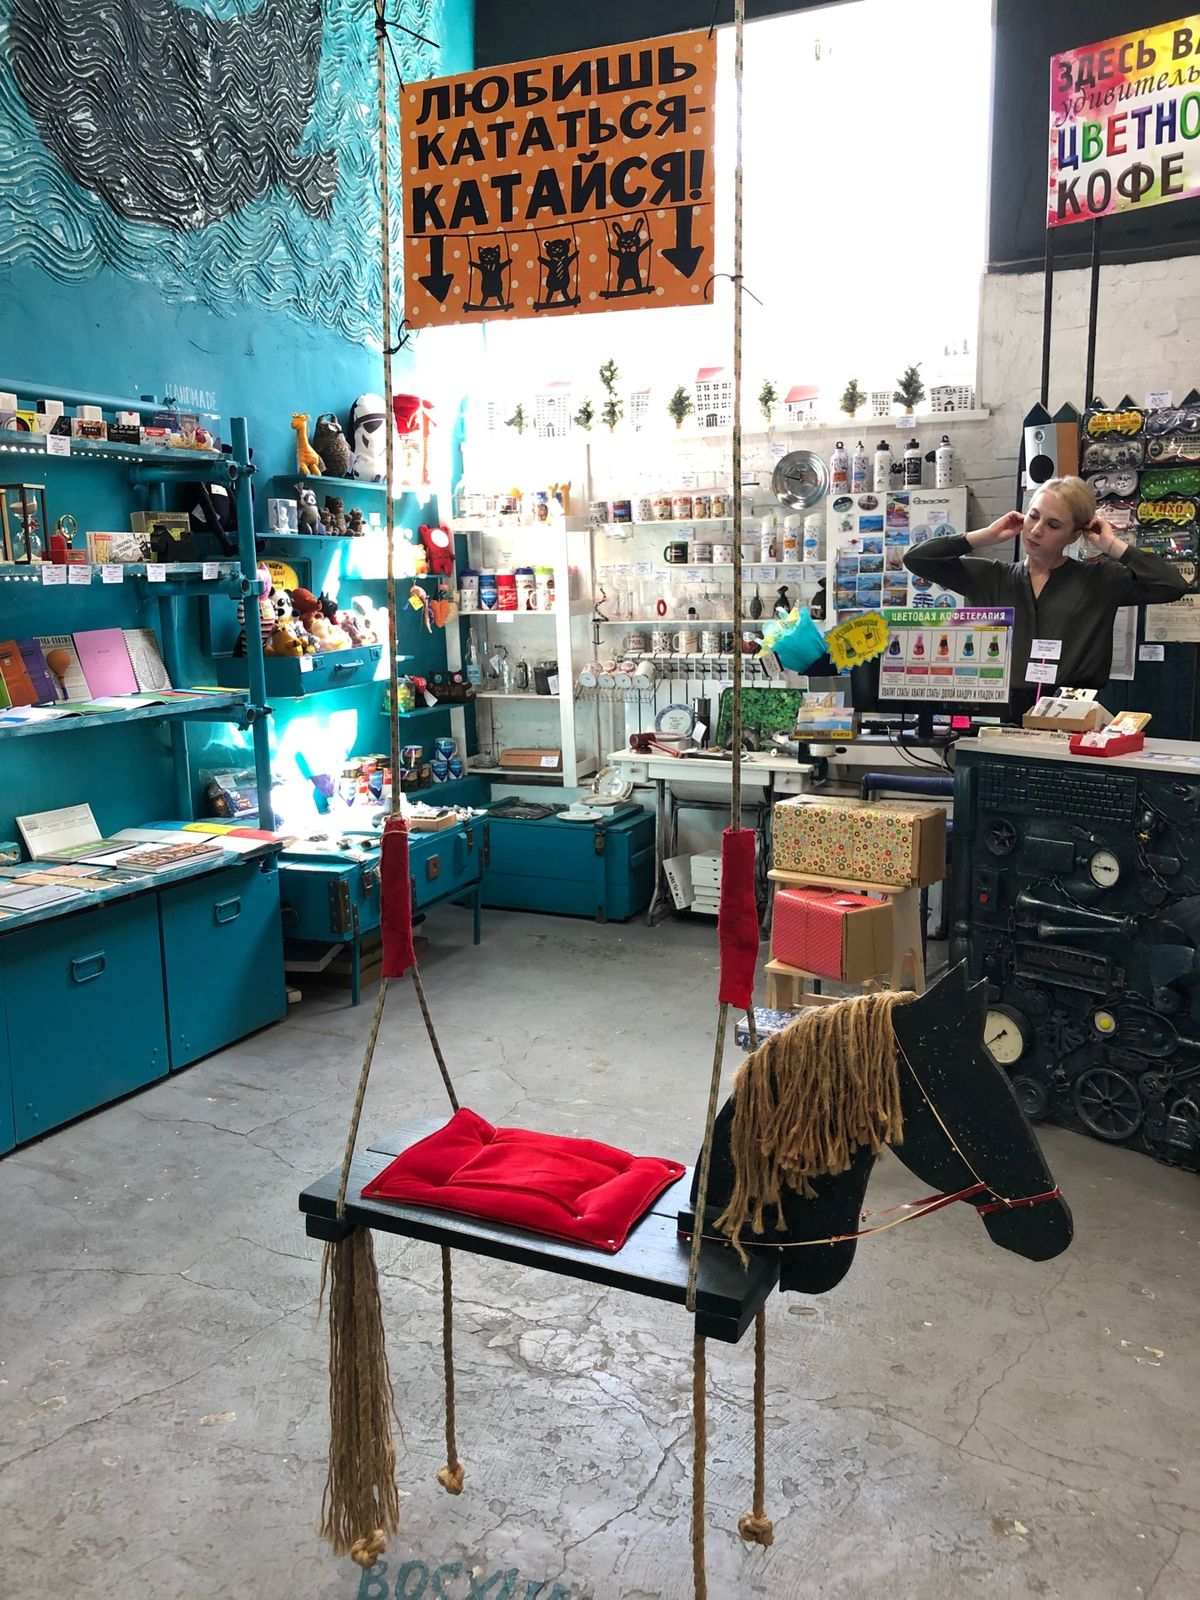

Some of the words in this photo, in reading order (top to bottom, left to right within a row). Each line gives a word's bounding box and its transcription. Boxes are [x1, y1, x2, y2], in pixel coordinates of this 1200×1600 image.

[416, 46, 698, 126] ЛЮБИШЬ
[1058, 39, 1156, 93] ЗДЕСЬ
[1172, 28, 1200, 61] В
[417, 95, 707, 171] КАТАТЬСЯ-
[1058, 91, 1200, 171] ЦВЕТНО
[411, 149, 706, 234] КАТАЙСЯ!
[1057, 151, 1185, 220] КОФЕ
[165, 383, 218, 411] HANDMADE
[1152, 504, 1183, 513] ТИХО
[891, 612, 936, 622] ЦВЕТОВАЯ
[940, 611, 1006, 621] КОФЕТЕРАПИЯ
